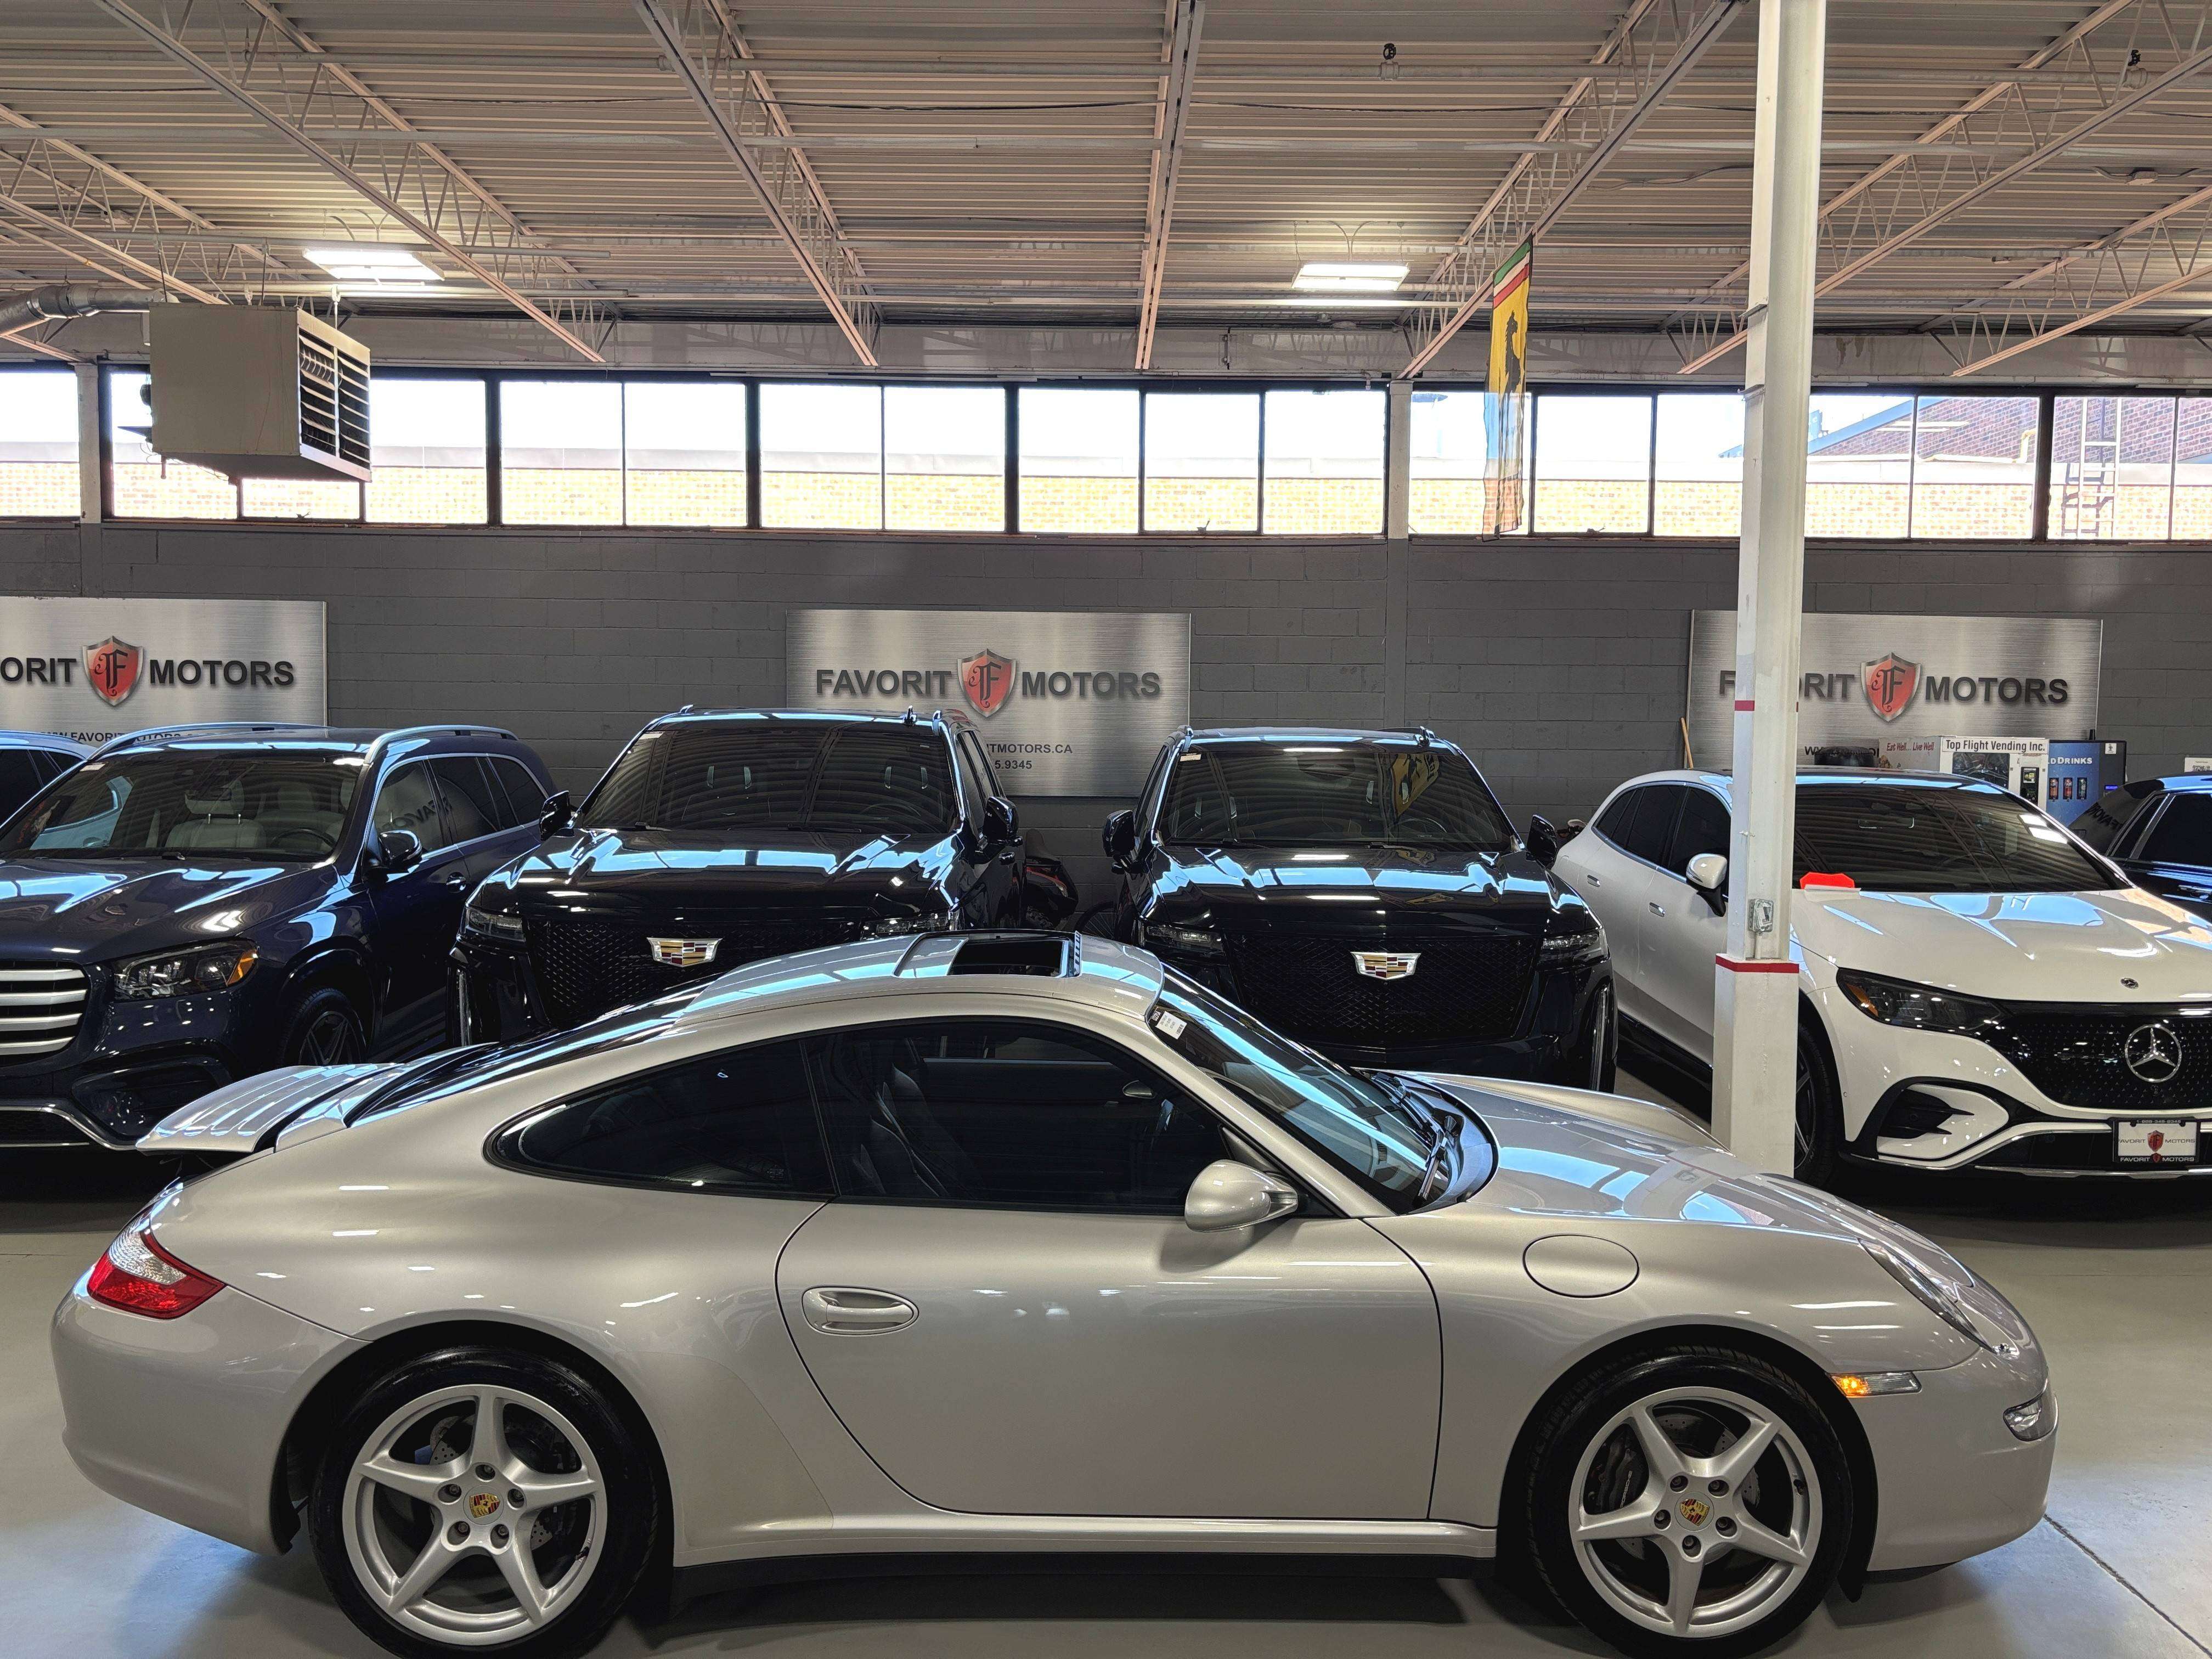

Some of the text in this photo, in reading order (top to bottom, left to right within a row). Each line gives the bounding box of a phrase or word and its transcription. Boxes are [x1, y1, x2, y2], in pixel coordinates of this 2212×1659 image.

[150, 659, 295, 686] MOTORS
[816, 669, 952, 696] FAVORIT
[1022, 672, 1161, 697] MOTORS
[1925, 676, 2069, 704] MOTORS
[1886, 742, 1896, 752] Eat
[1912, 742, 1923, 751] Live
[1923, 742, 1934, 751] Well
[1946, 740, 2045, 752] Top Flight Vending Inc.
